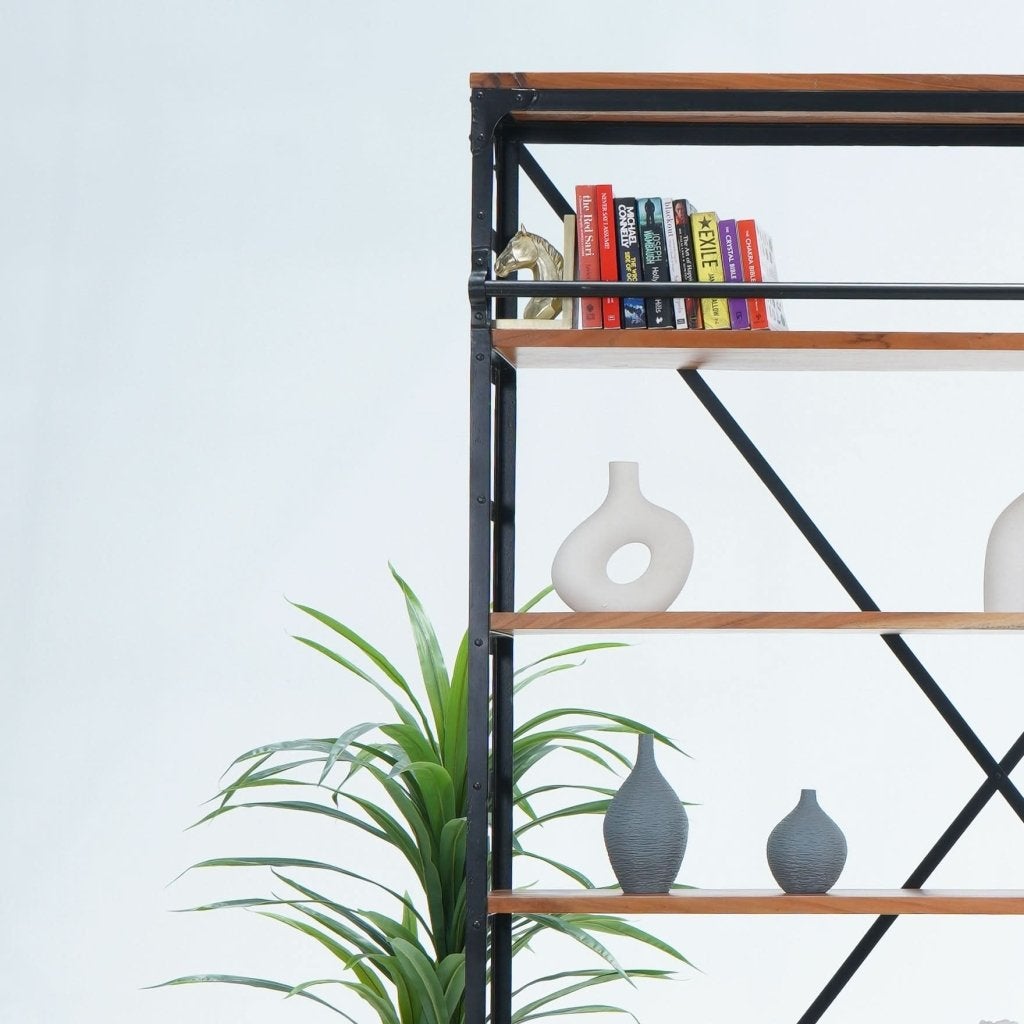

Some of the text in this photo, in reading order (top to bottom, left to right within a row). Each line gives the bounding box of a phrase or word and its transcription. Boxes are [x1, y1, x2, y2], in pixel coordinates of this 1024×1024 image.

[582, 195, 592, 211] the
[583, 214, 594, 233] Red
[618, 204, 630, 248] CONNELLY
[626, 206, 637, 246] MICHAEL
[664, 201, 674, 237] blackout
[585, 235, 595, 256] Sari
[643, 230, 655, 265] WAMBAUGH
[652, 233, 662, 262] JOSEPH
[698, 230, 719, 268] EXILE
[725, 234, 735, 263] CRYSTAL
[745, 238, 754, 265] CHAKRA
[651, 266, 659, 282] Holly
[729, 263, 737, 279] BIBLE
[749, 265, 757, 282] BIBLE
